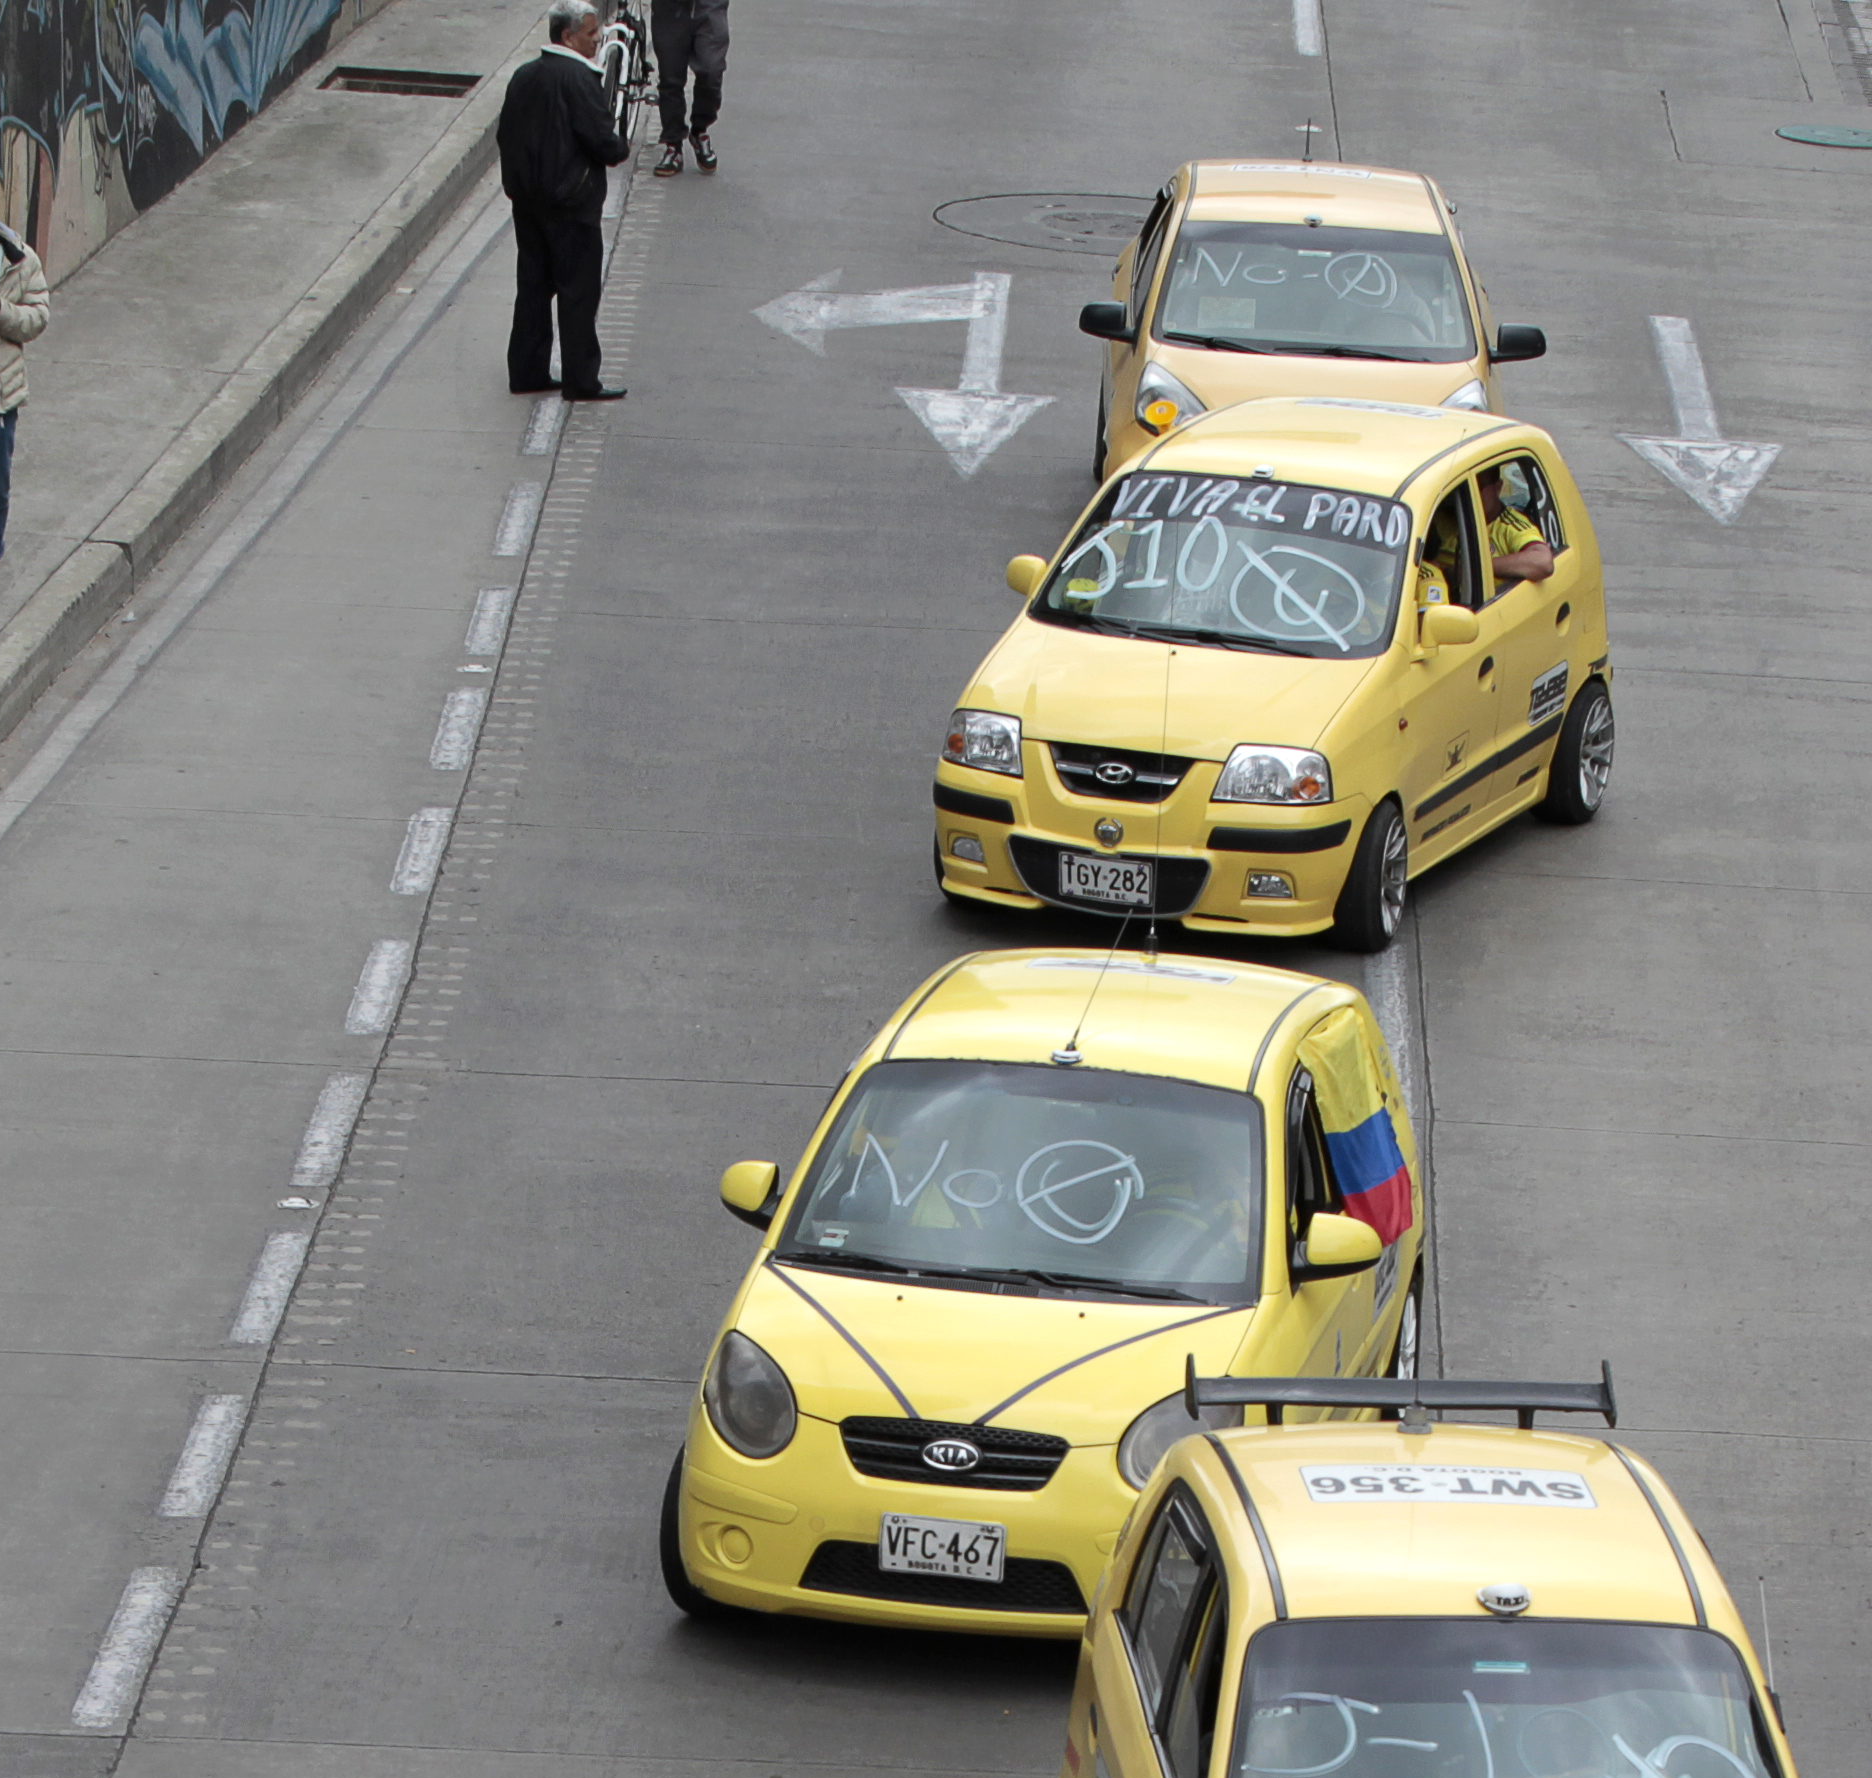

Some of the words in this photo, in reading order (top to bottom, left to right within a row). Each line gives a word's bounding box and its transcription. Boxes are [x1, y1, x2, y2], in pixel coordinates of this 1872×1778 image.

[1112, 477, 1240, 519] VIVA
[1241, 485, 1286, 524] EL
[932, 1446, 968, 1464] KIA
[1422, 1467, 1522, 1476] BOGOTA
[908, 1560, 946, 1572] BOGOTA
[1495, 1595, 1524, 1606] TAXI
